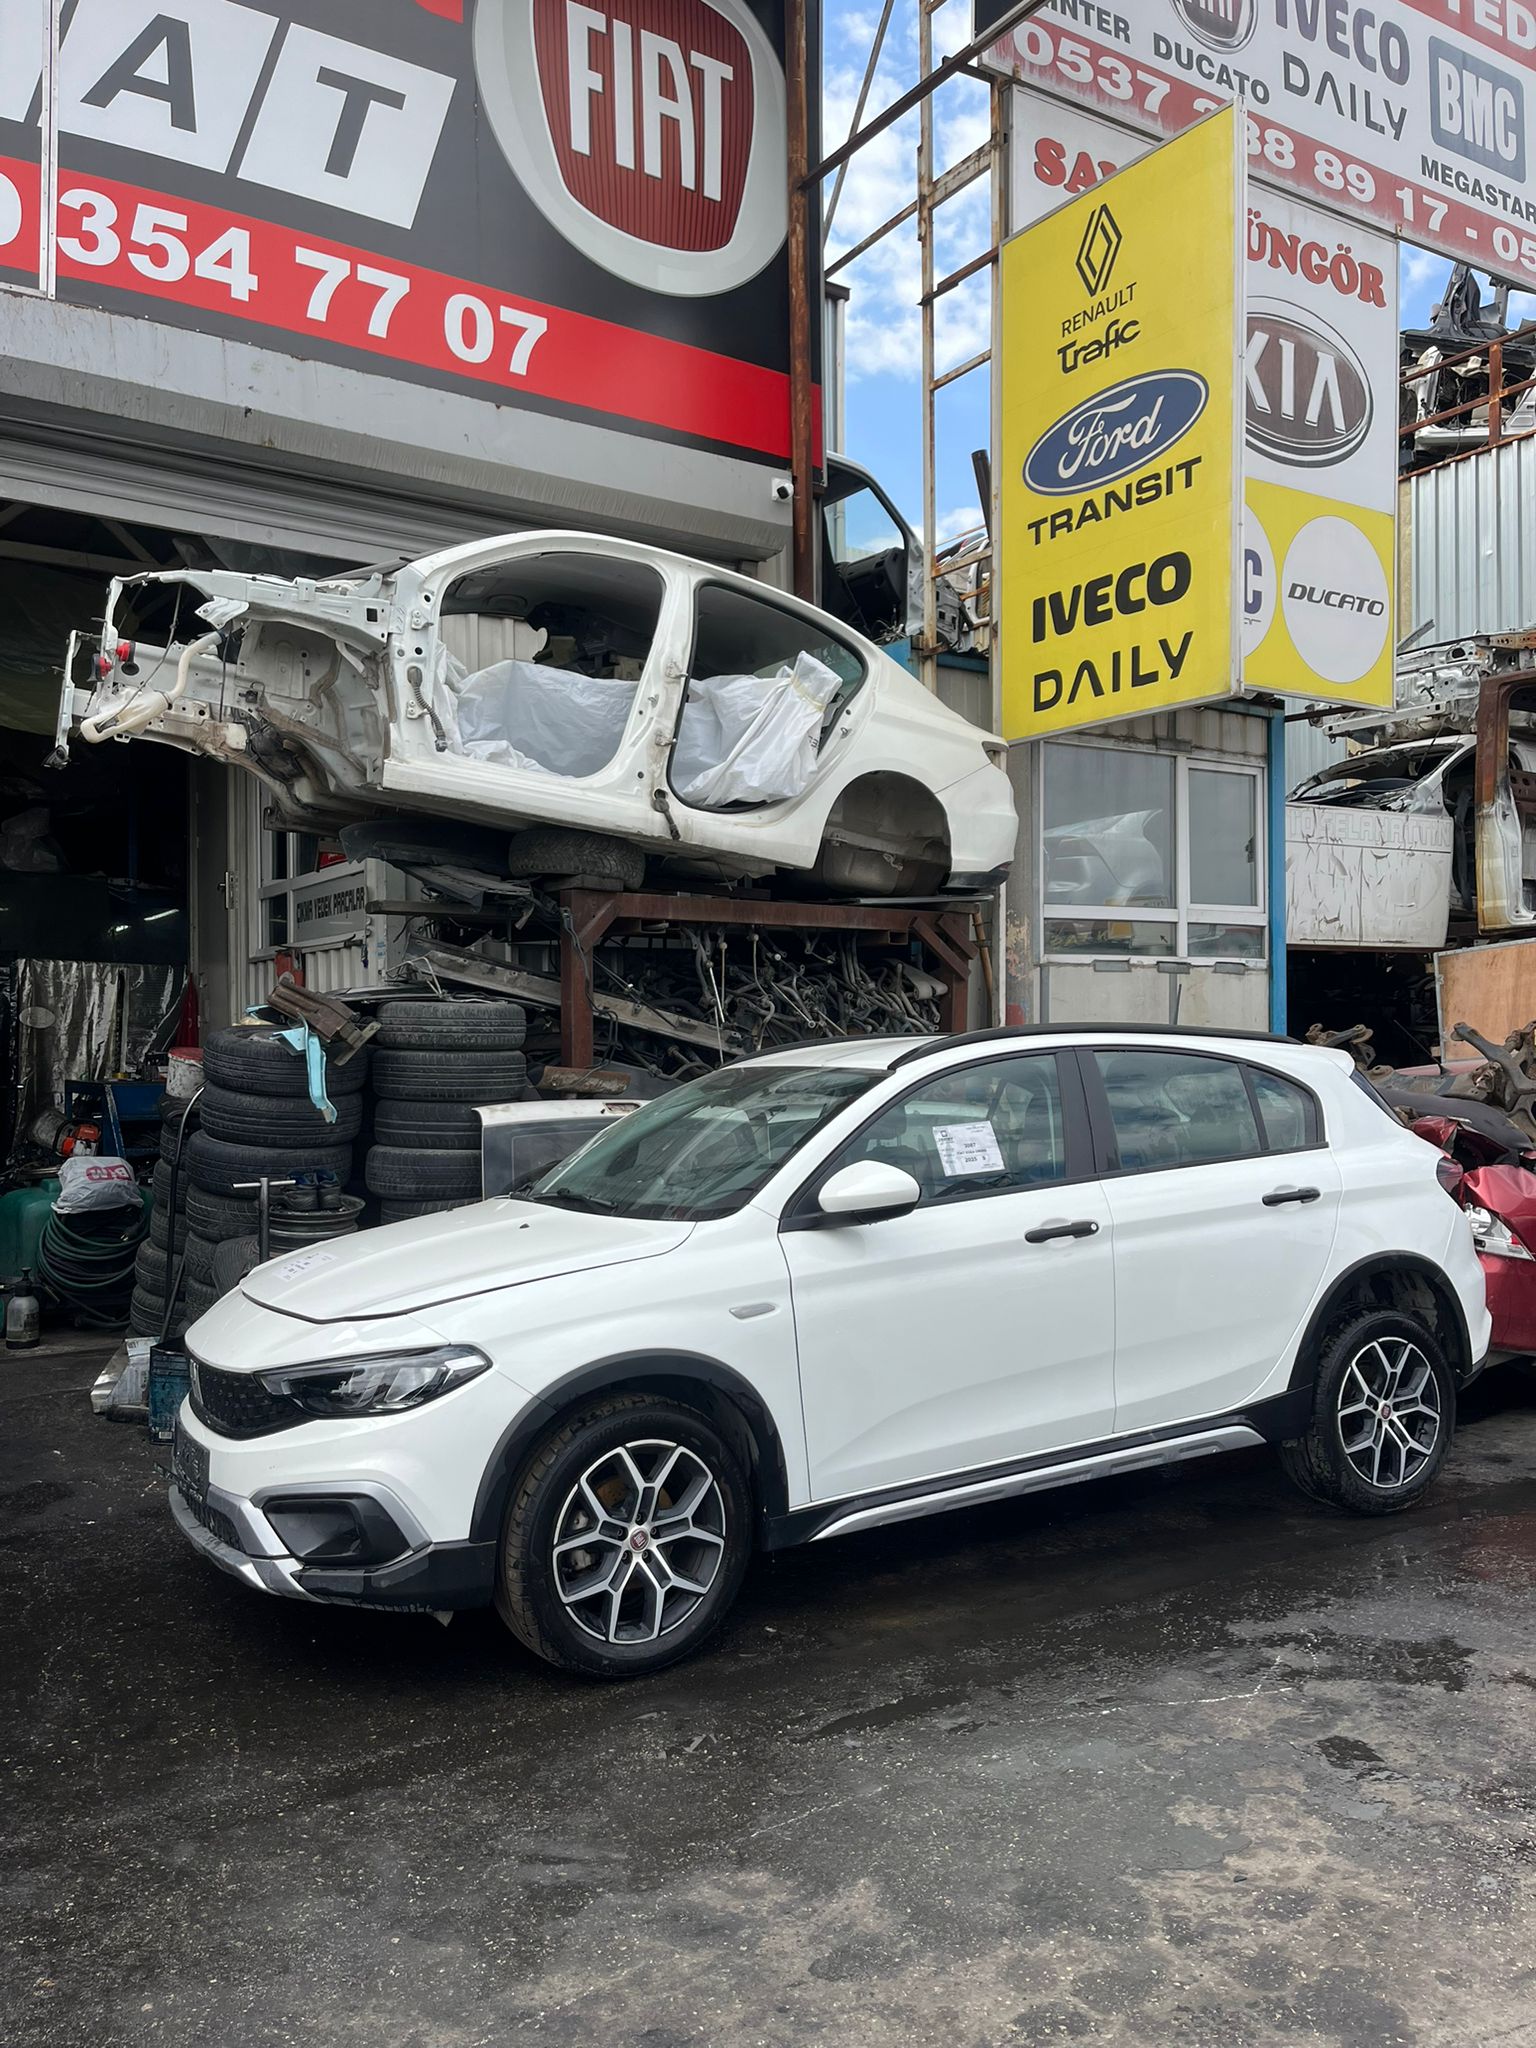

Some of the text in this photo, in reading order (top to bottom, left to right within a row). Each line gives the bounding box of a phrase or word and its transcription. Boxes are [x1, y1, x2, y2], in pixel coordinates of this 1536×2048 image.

[566, 0, 733, 201] FIAT
[1153, 33, 1270, 104] DUCATO
[1283, 51, 1407, 141] DAILY
[1438, 57, 1517, 161] BMC
[1013, 21, 1170, 114] 0537
[1314, 150, 1376, 203] 89
[1396, 186, 1449, 232] 17
[57, 188, 259, 303] 354
[294, 245, 410, 339] 77
[443, 293, 549, 376] 07
[1061, 282, 1137, 338] RENAULT
[1057, 318, 1141, 374] Trafic
[1058, 393, 1163, 480] Ford
[1027, 456, 1202, 546] TRANSIT
[1032, 551, 1192, 643] IVECO
[1288, 582, 1384, 617] DUCATO
[1034, 630, 1194, 712] DAILY
[314, 894, 332, 919] YEDEK
